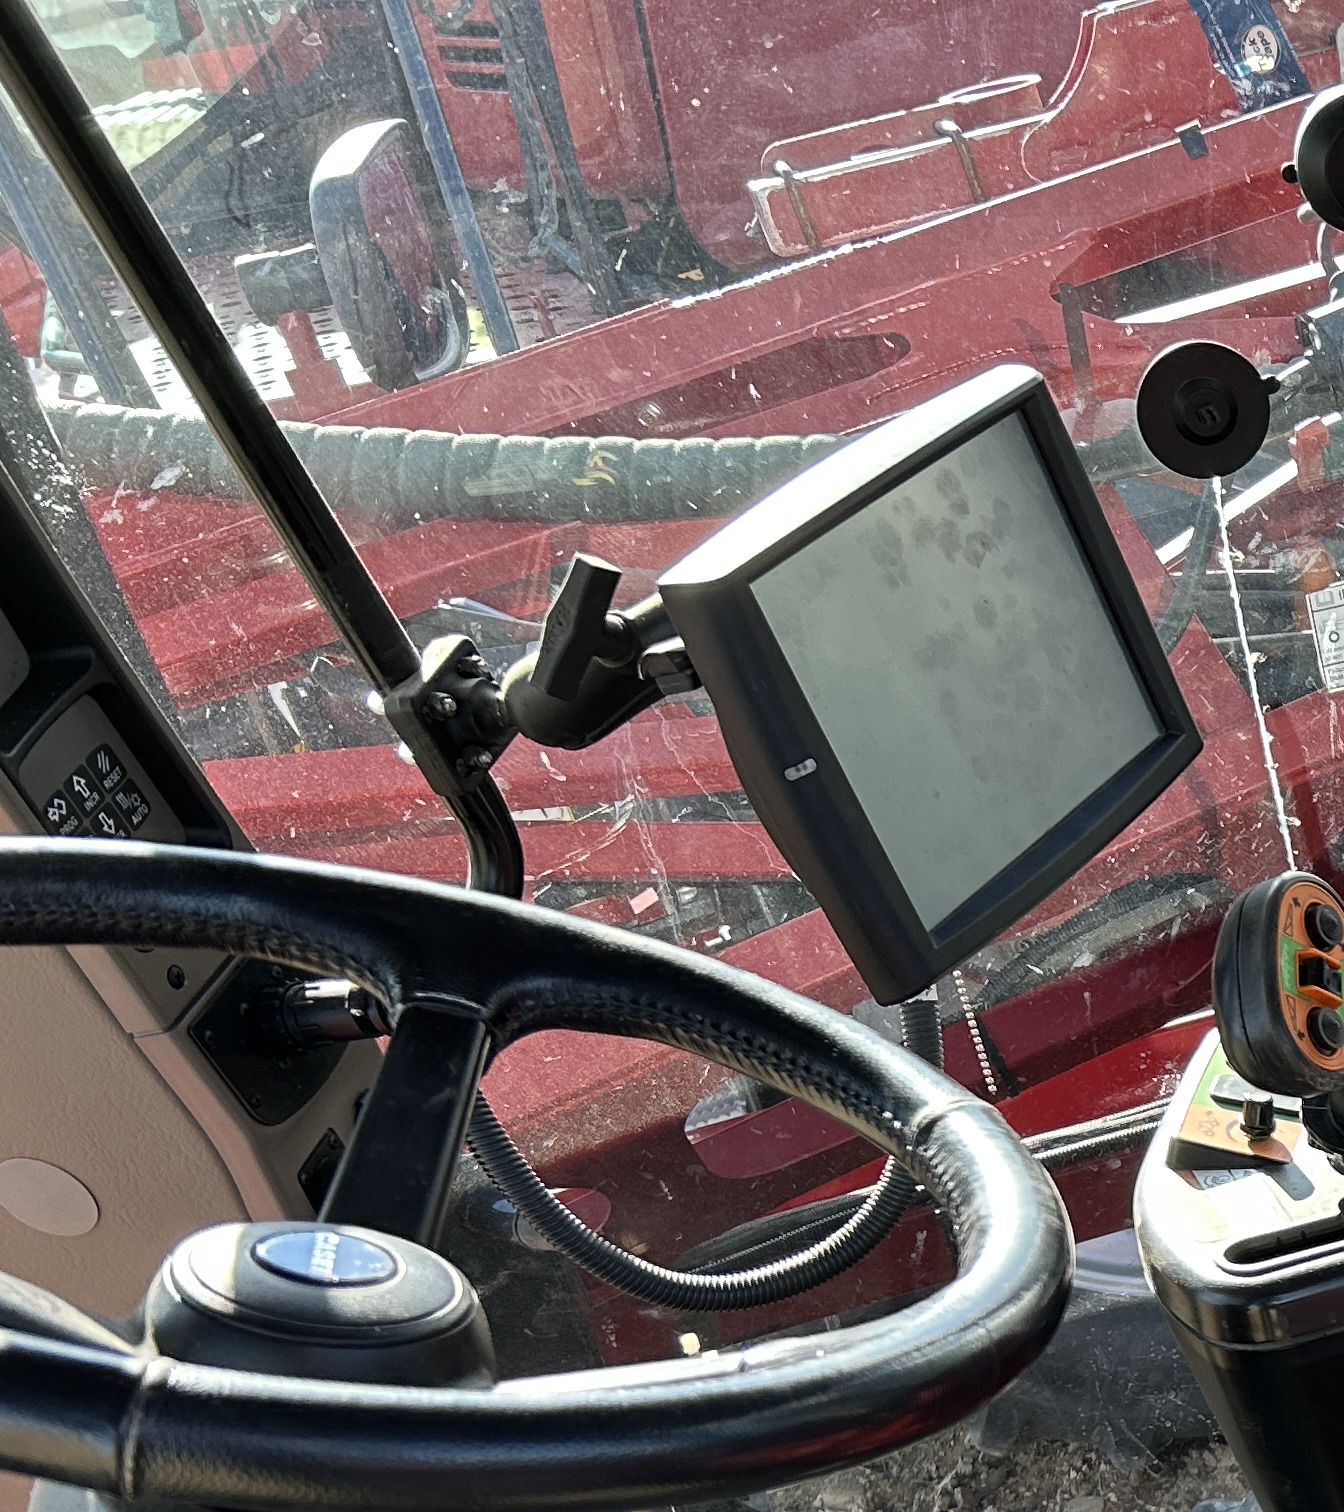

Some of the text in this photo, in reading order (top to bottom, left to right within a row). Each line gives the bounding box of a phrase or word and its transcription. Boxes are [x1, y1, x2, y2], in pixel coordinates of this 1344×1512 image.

[103, 767, 122, 790] RESET
[83, 791, 101, 812] INCR
[59, 815, 79, 835] PROG
[131, 803, 149, 826] AUTO
